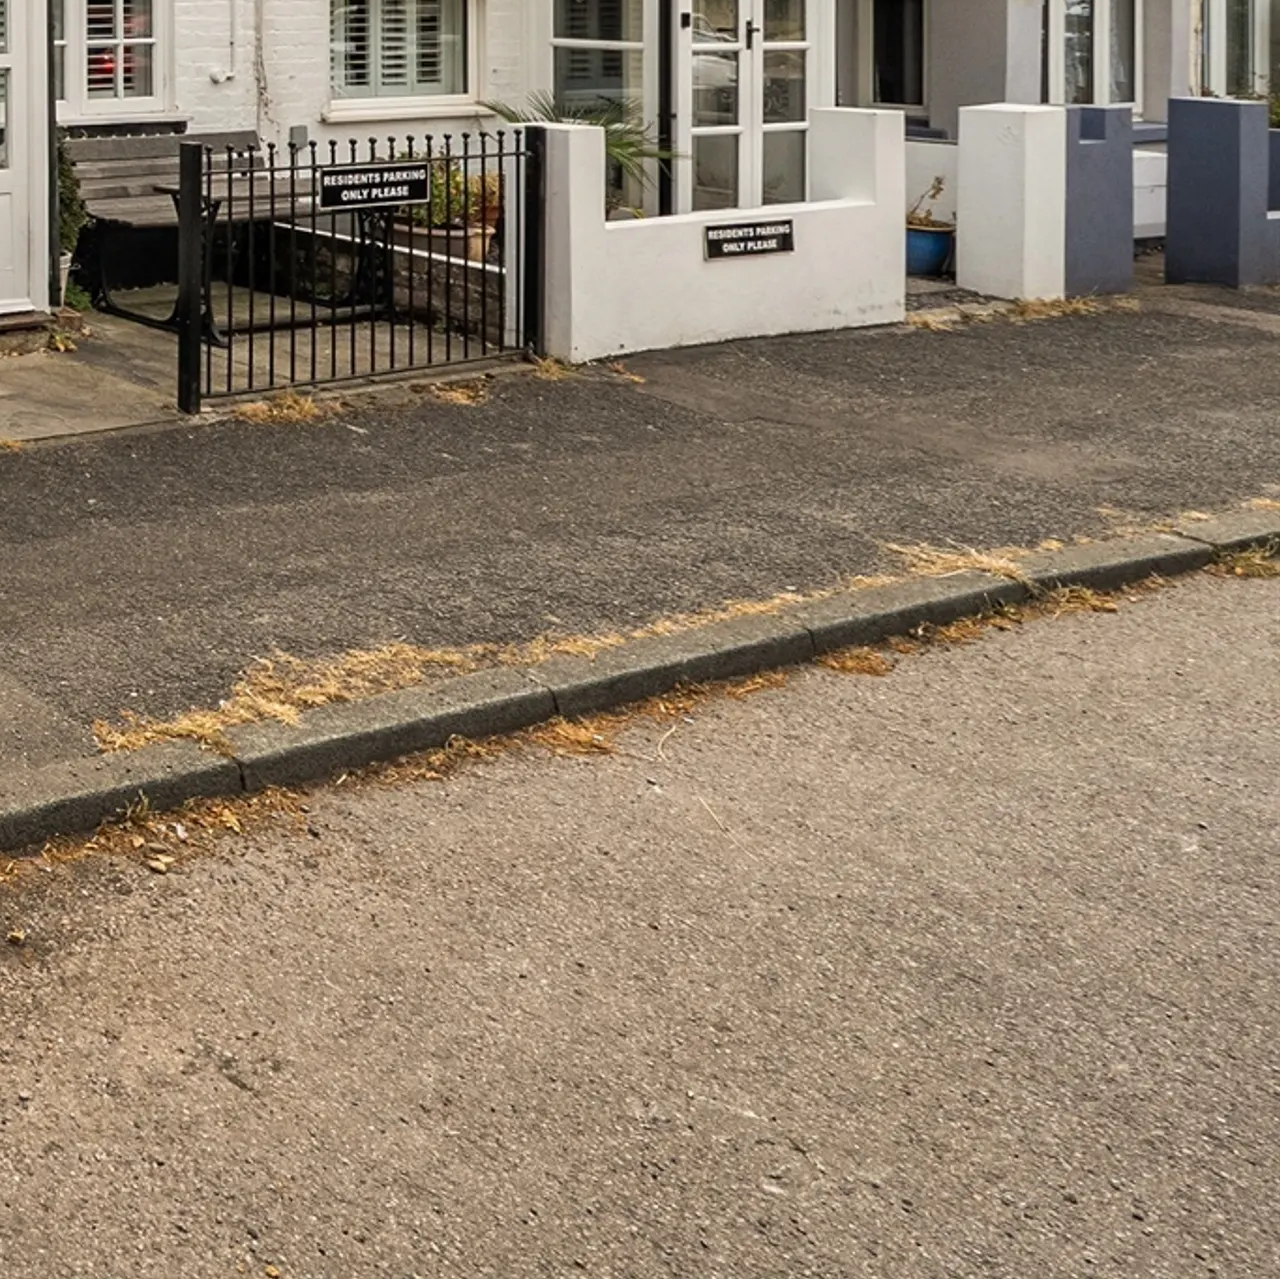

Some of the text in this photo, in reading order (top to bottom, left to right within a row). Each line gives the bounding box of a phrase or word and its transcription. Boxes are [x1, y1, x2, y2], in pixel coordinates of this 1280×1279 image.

[323, 169, 426, 186] RESIDENTS PARKING
[341, 185, 409, 201] ONLY PLEASE
